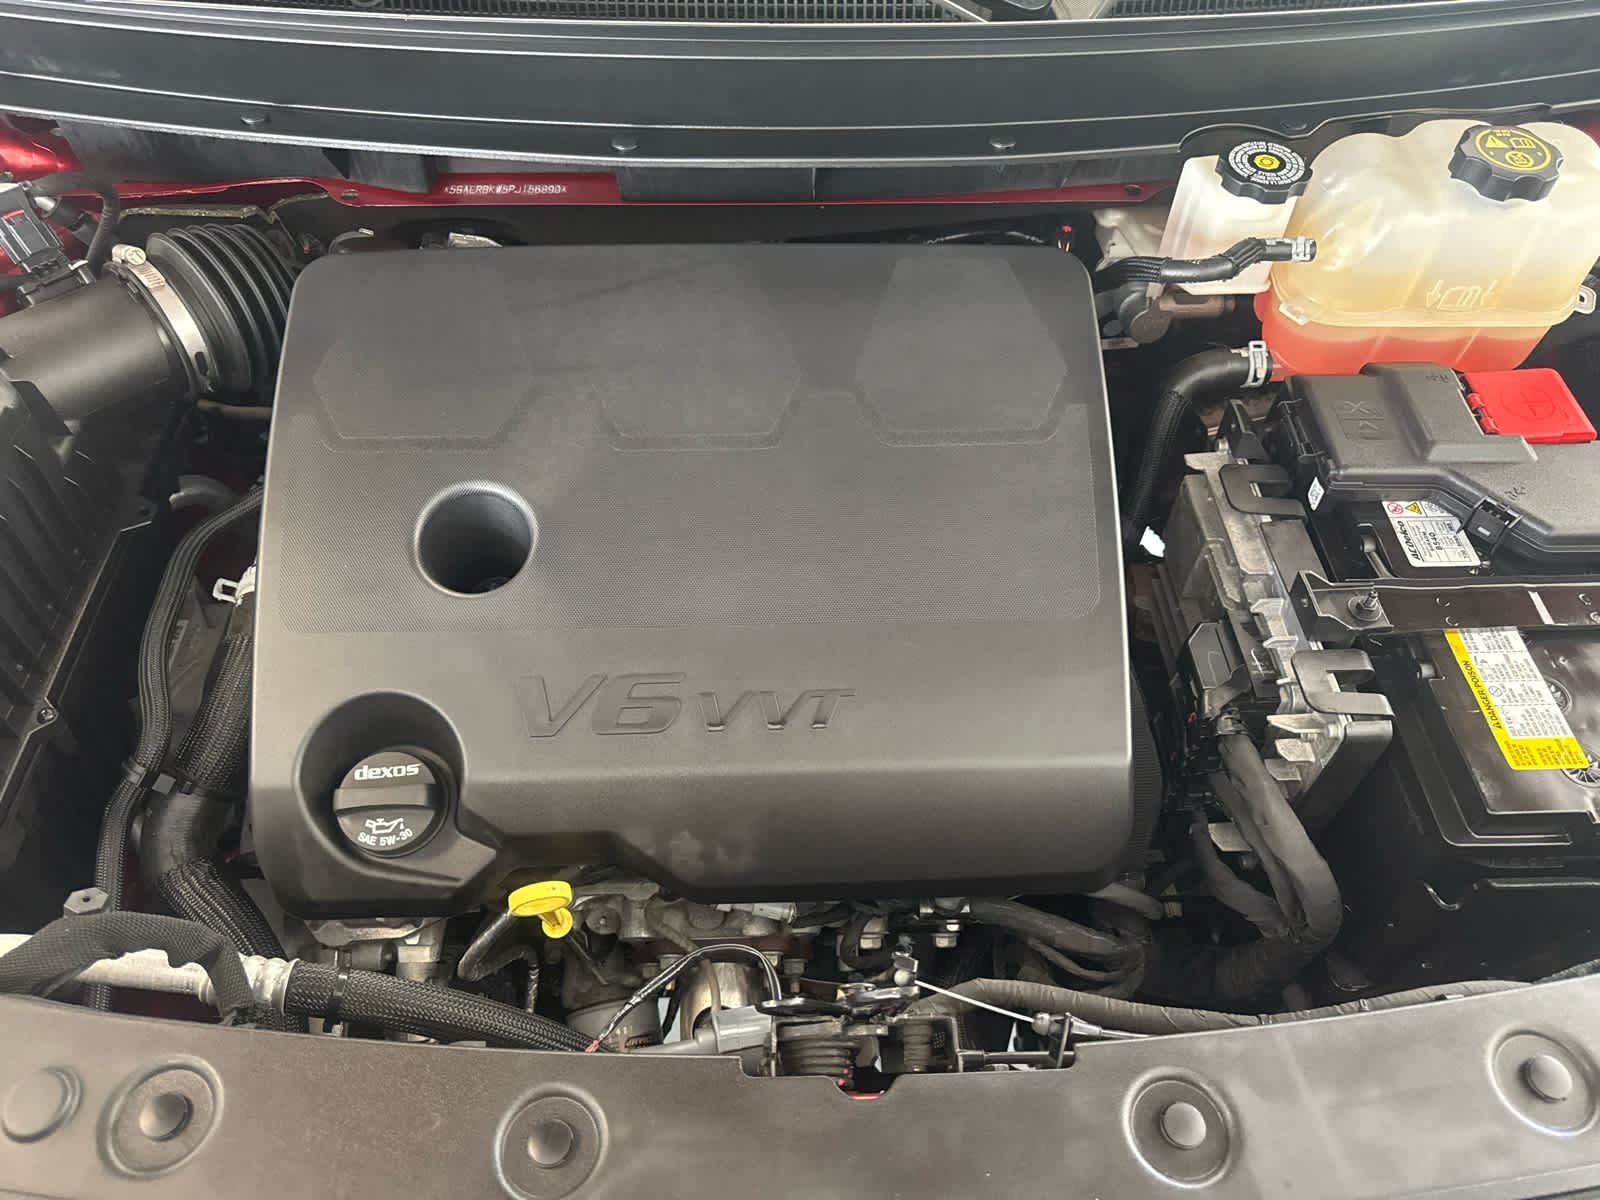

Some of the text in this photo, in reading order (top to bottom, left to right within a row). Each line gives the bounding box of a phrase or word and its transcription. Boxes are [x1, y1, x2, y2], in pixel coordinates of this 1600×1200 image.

[1398, 520, 1420, 560] ACDelco
[517, 672, 856, 738] V6 VVT
[353, 763, 423, 780] dexos
[357, 828, 413, 847] SAE 5W-30
